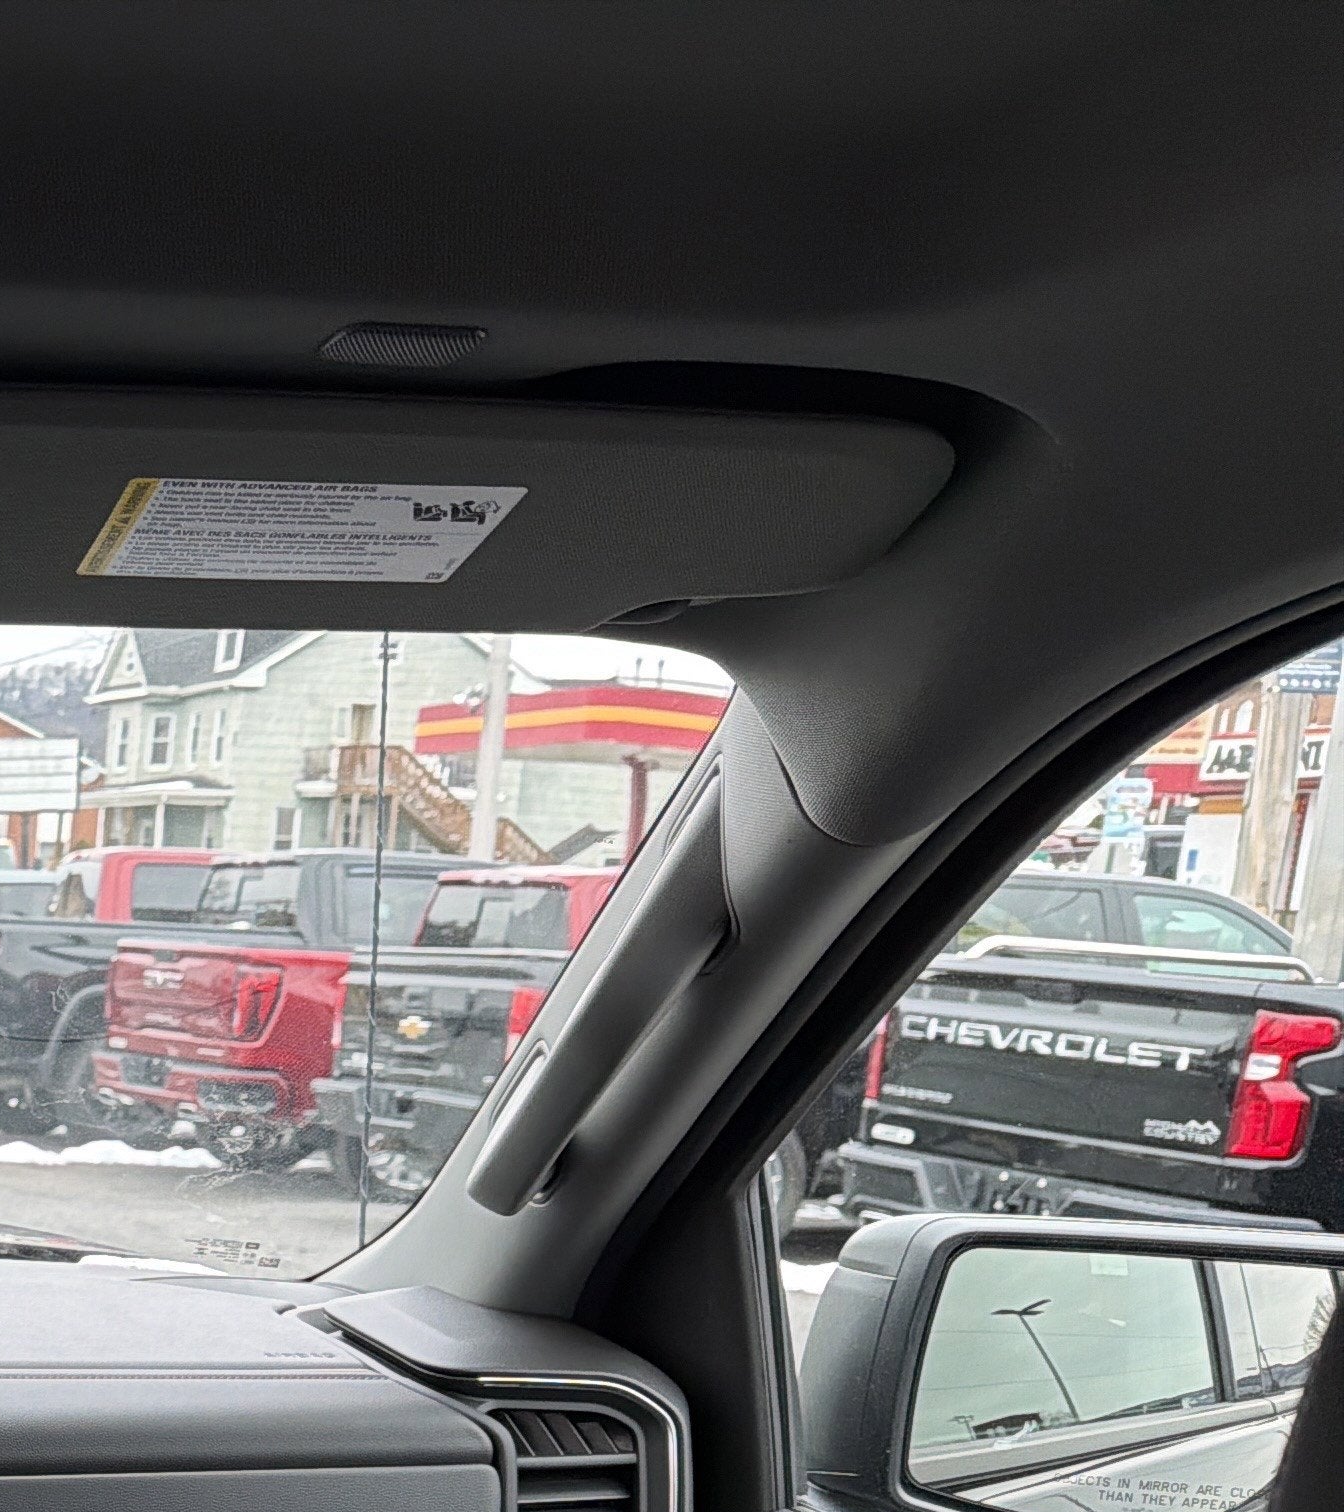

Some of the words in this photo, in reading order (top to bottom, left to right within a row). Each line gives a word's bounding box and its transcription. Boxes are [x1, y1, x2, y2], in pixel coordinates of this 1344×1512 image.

[237, 483, 311, 491] ADVANCED
[901, 1014, 1207, 1072] CHEVROLET
[1117, 1478, 1131, 1489] IN
[1139, 1480, 1188, 1494] MIRROR
[1196, 1485, 1223, 1497] ARE
[1099, 1490, 1134, 1503] THAN
[1142, 1493, 1176, 1507] THEY
[1181, 1498, 1239, 1511] APPEAR
